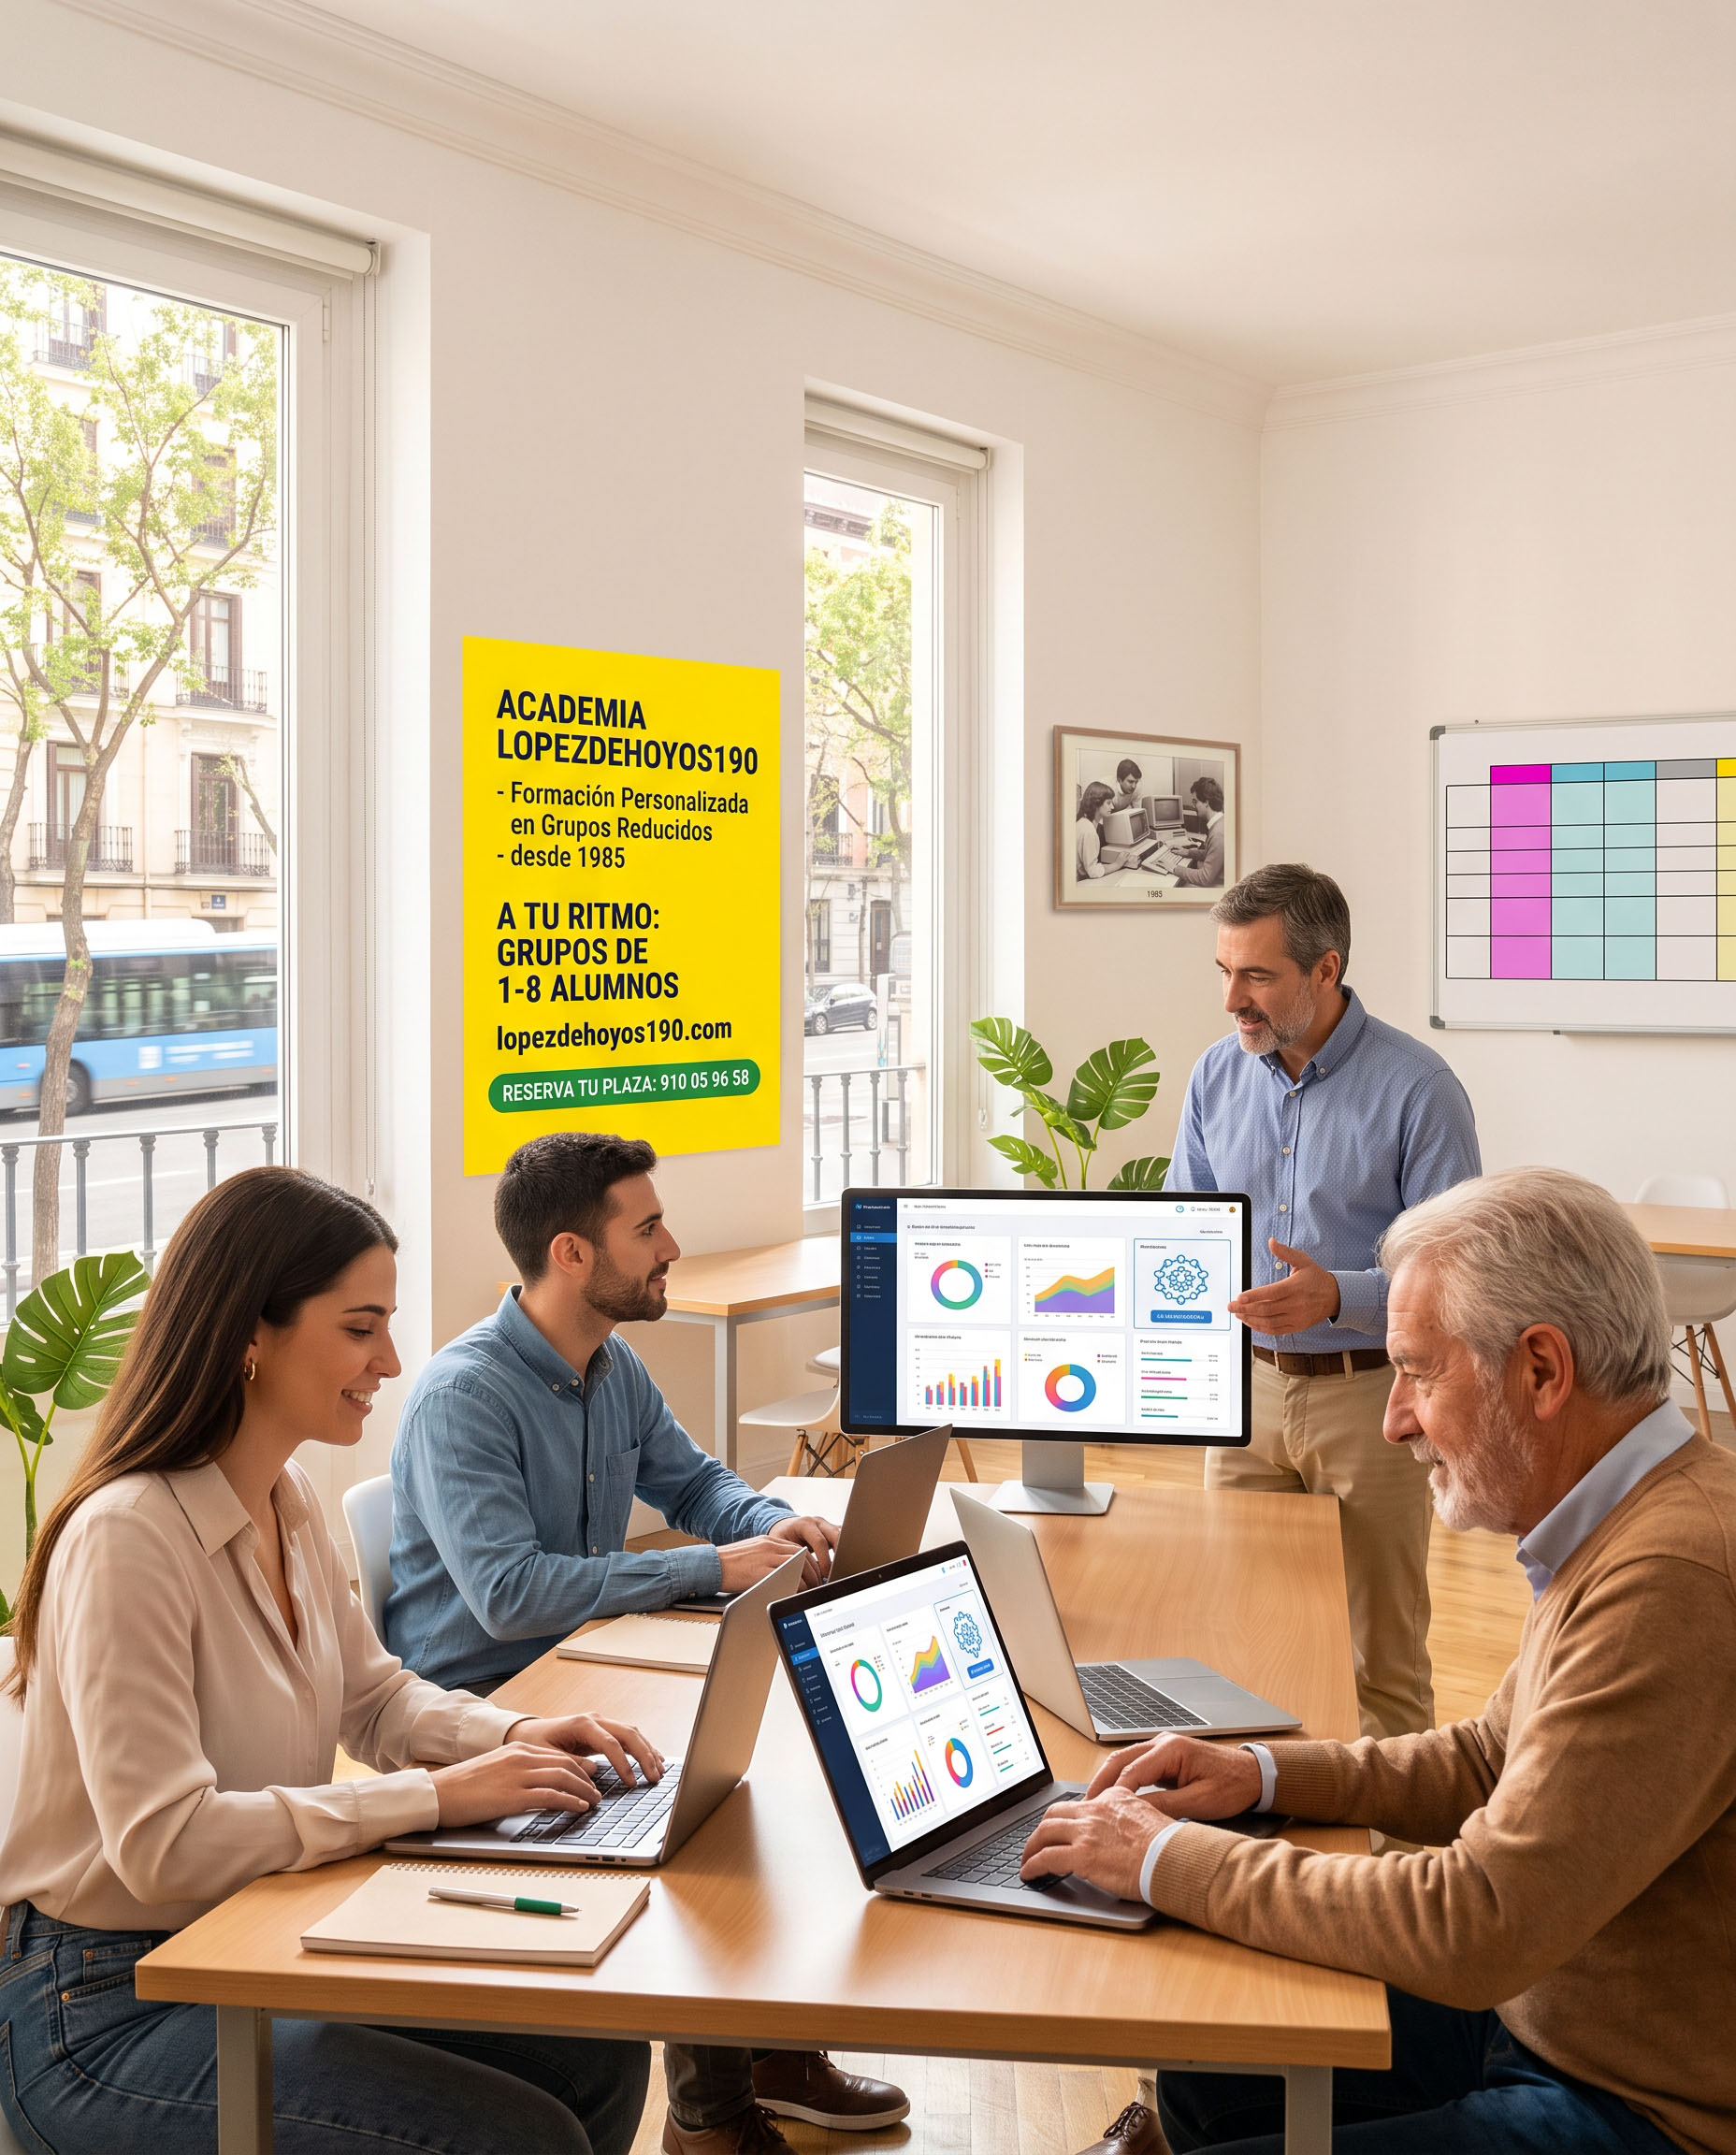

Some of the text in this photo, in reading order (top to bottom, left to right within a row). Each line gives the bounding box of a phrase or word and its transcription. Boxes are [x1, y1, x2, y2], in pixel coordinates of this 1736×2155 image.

[496, 688, 647, 730] ACADEMIA
[497, 729, 759, 775] LOPEZDEHOYOS190
[511, 781, 615, 810] Formación
[621, 787, 749, 815] Personalizada
[511, 813, 713, 843] en Grupos Reducidos
[511, 843, 571, 868] desde
[578, 846, 626, 869] 1985
[496, 902, 659, 931] A TU RITMO:
[497, 937, 648, 967] GRUPOS DE
[499, 971, 679, 1004] 1-8 ALUMNOS
[497, 1018, 732, 1056] lopezdehoyos190.com
[502, 1068, 749, 1103] RESERVA TU PLAZA: 910 05 96 58
